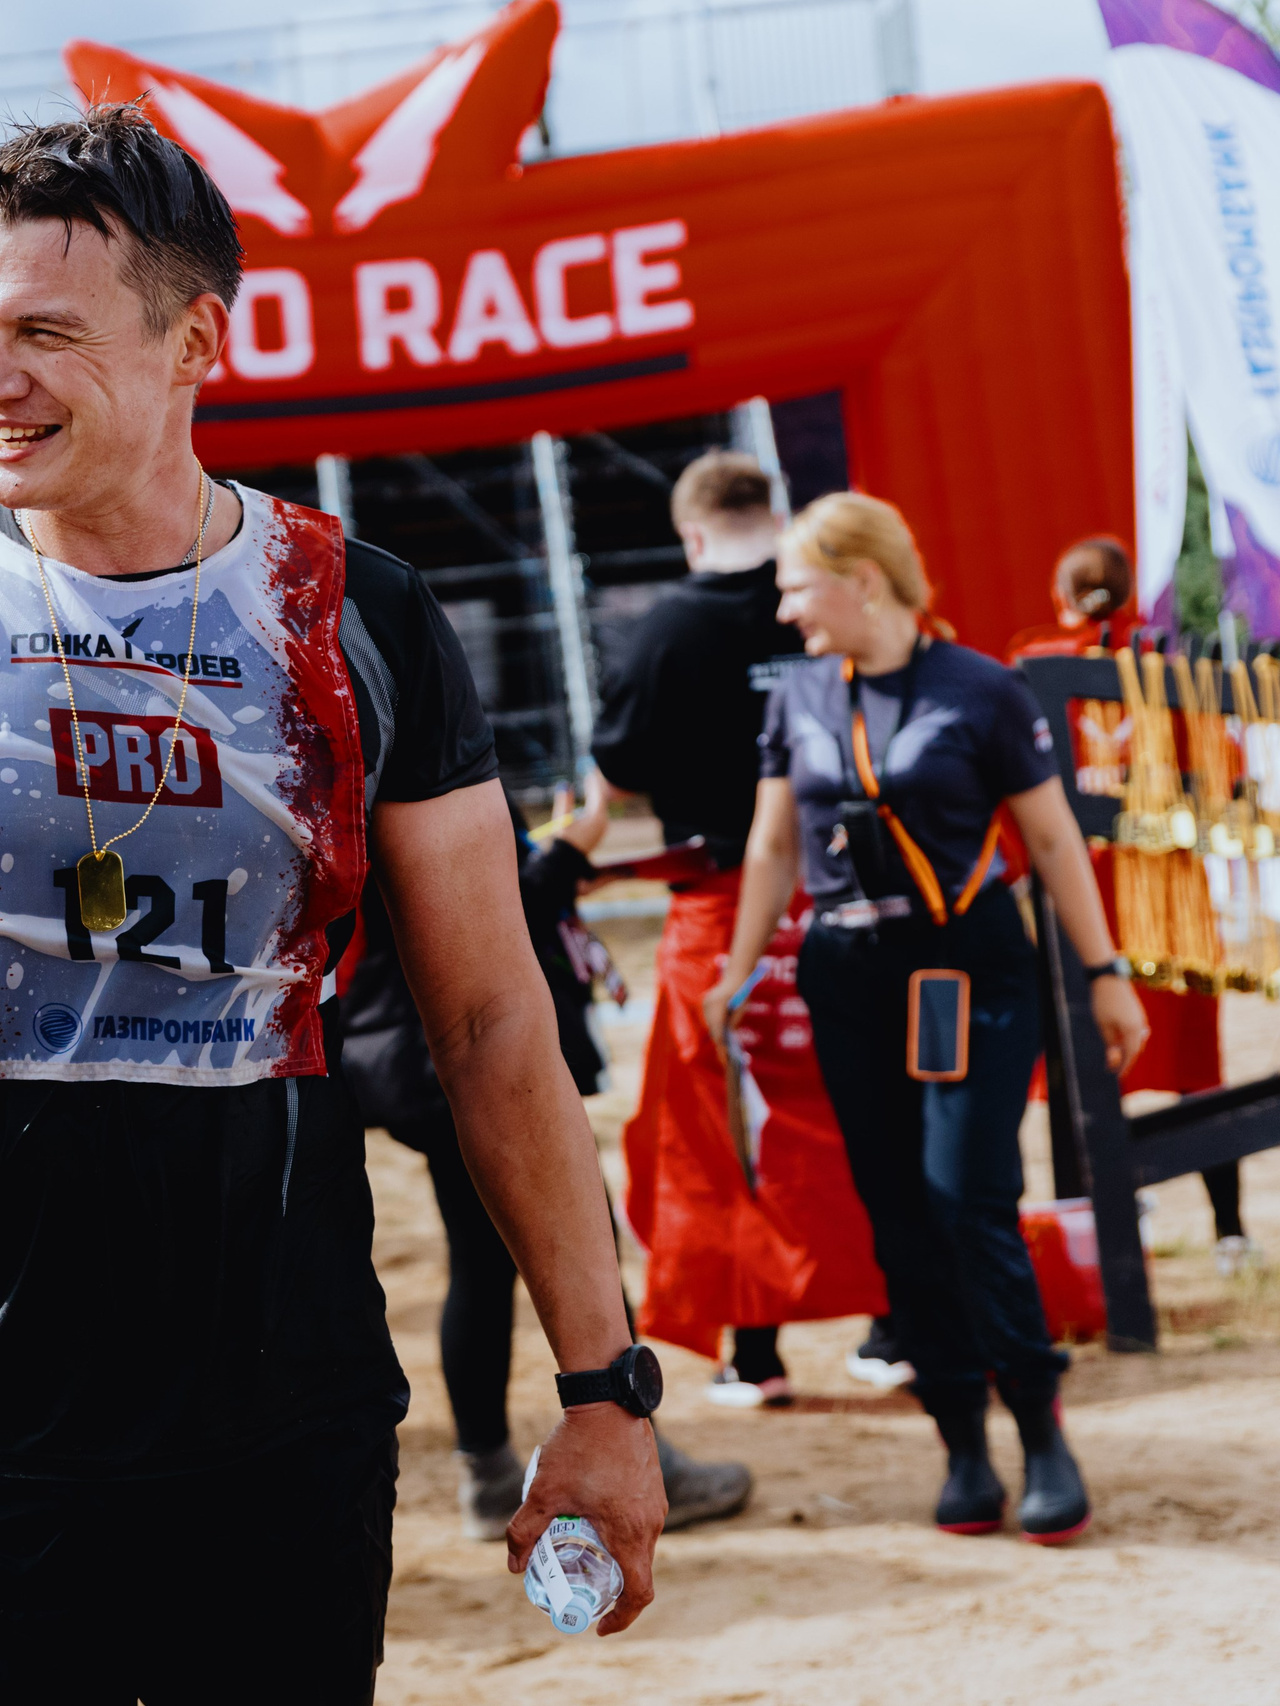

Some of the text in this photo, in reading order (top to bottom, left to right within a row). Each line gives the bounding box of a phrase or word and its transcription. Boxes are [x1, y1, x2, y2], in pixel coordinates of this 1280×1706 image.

[354, 218, 695, 371] RACE
[11, 633, 116, 658] ГОНКА
[70, 720, 205, 796] PRO
[53, 867, 236, 974] 121
[93, 1015, 256, 1044] ГАЗПРОМБАНК
